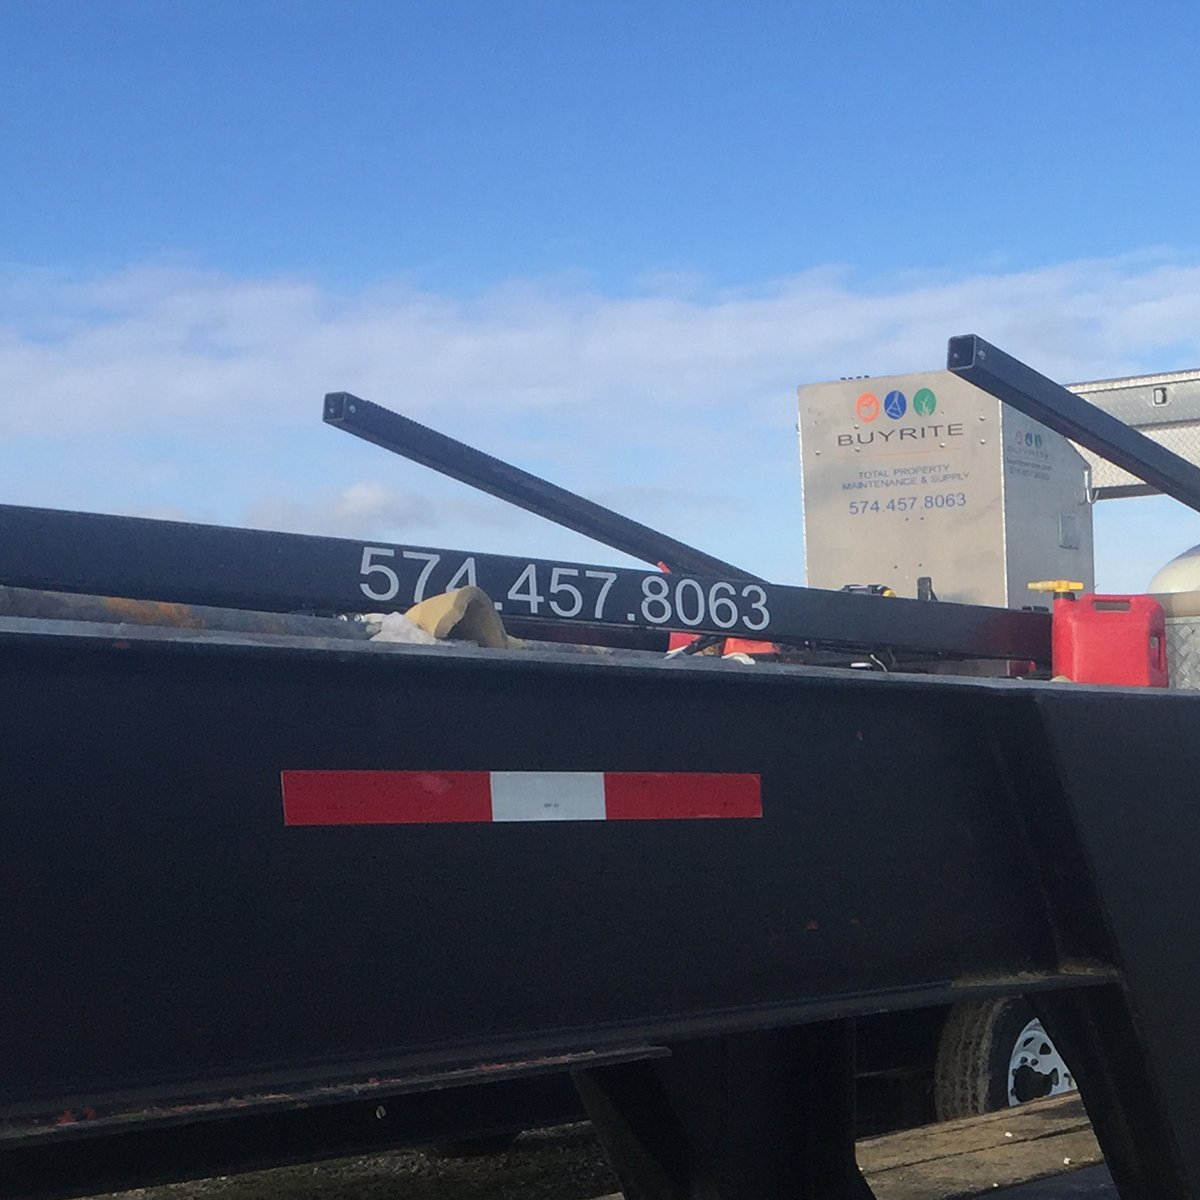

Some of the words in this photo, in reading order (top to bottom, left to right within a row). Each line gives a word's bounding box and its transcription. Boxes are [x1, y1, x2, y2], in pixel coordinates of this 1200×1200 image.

[838, 423, 964, 447] BUYRITE
[842, 477, 917, 490] MAINTENANCE
[930, 472, 970, 483] SUPPLY
[858, 470, 890, 480] TOTAL
[893, 464, 950, 476] PROPERTY
